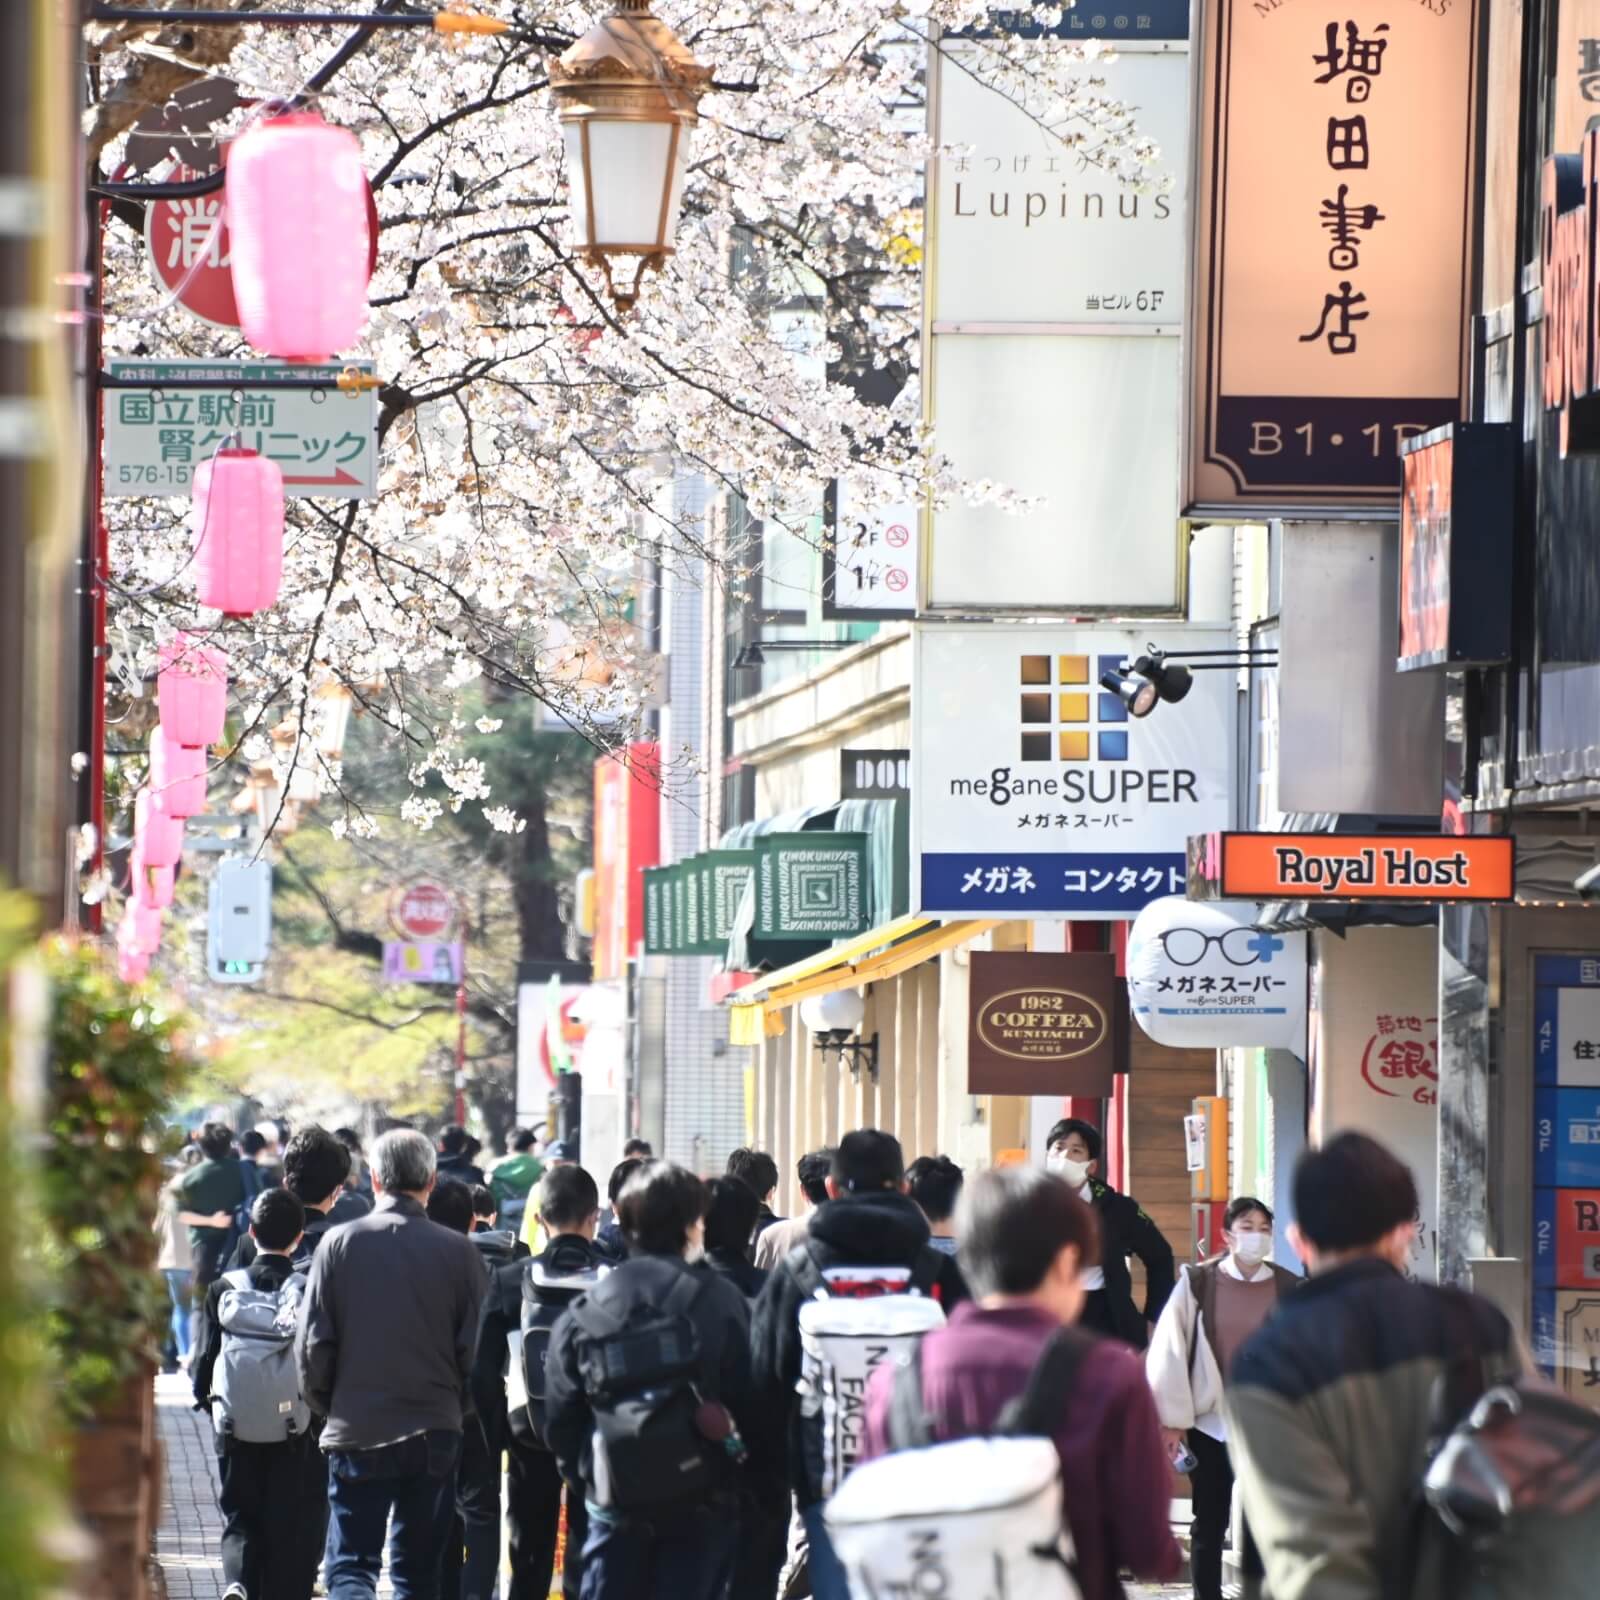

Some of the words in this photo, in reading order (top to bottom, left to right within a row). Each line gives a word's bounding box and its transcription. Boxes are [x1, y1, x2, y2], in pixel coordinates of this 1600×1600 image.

[954, 182, 1171, 227] Lupinus
[119, 394, 276, 426] 国立駅前
[158, 429, 367, 464] 腎クリニック
[119, 465, 195, 484] 576-15
[960, 866, 1037, 894] メガネ
[1063, 866, 1186, 893] コンタクト
[1275, 847, 1374, 892] Royal
[1382, 849, 1468, 886] Host
[761, 853, 772, 932] KINOKUNIYA
[1020, 996, 1063, 1010] 1982
[990, 1011, 1095, 1029] COFFEA
[1002, 1029, 1084, 1039] KUNITACHI
